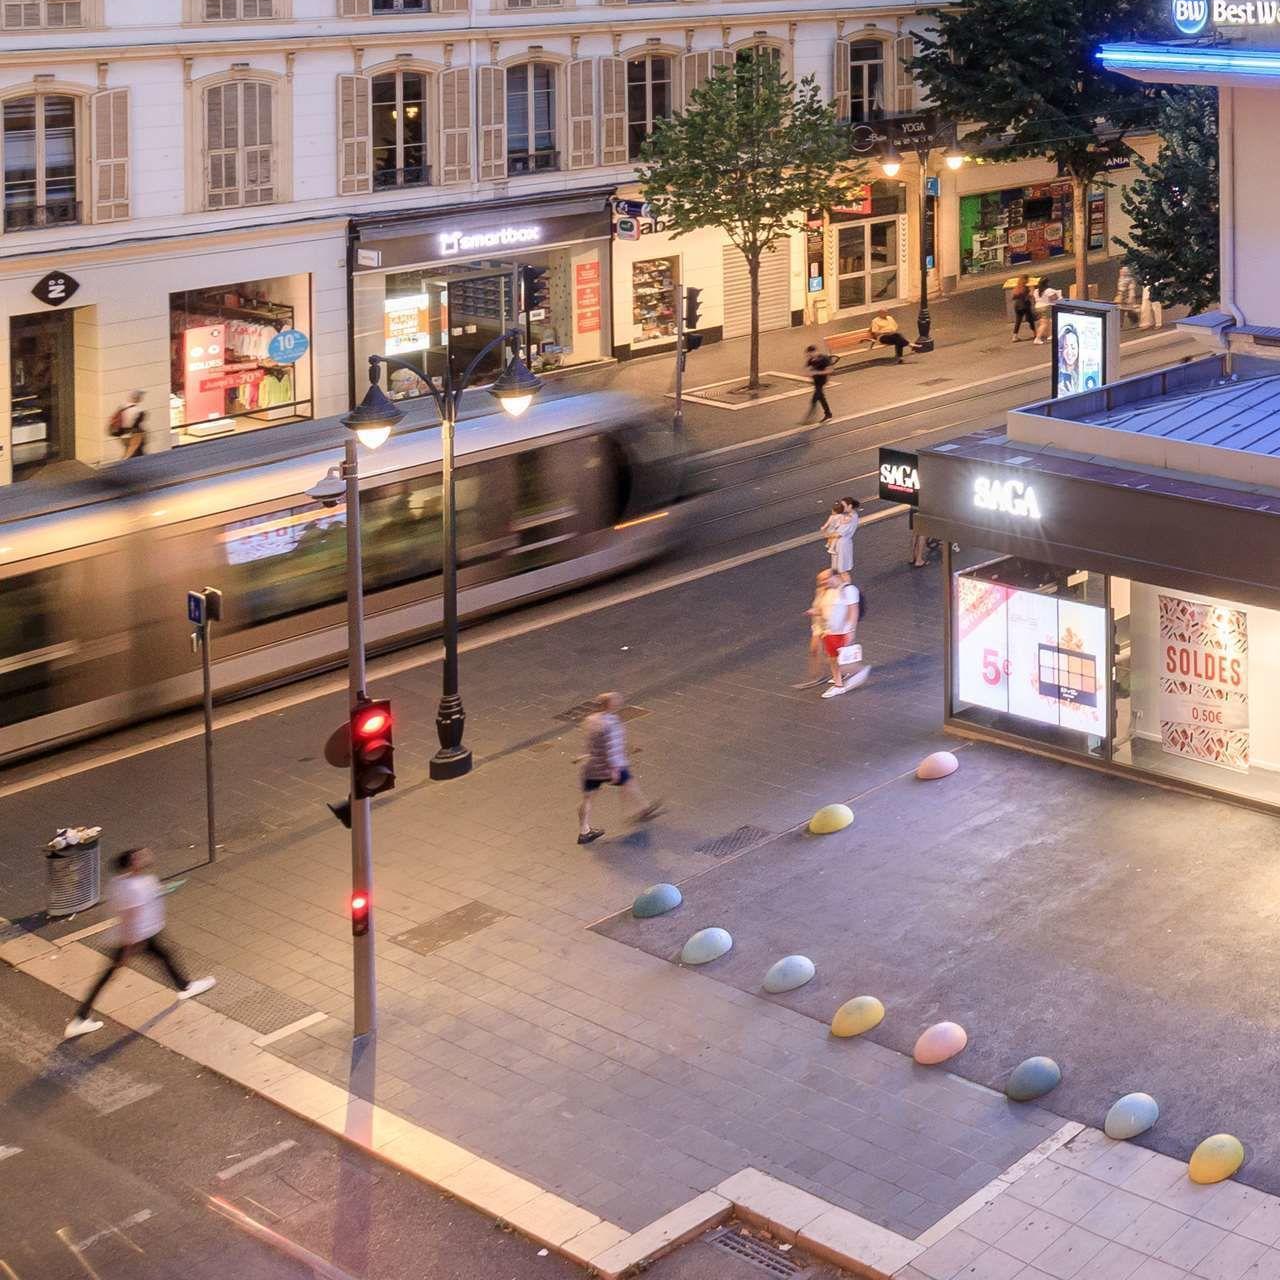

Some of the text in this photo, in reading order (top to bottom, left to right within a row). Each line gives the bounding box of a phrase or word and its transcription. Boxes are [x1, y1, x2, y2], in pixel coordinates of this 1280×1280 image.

[1176, 0, 1204, 21] BW
[1213, 0, 1255, 24] Best
[459, 227, 541, 251] smartbox
[879, 463, 920, 490] SAGA
[973, 476, 1042, 519] SAGA
[1166, 645, 1241, 686] SOLDES
